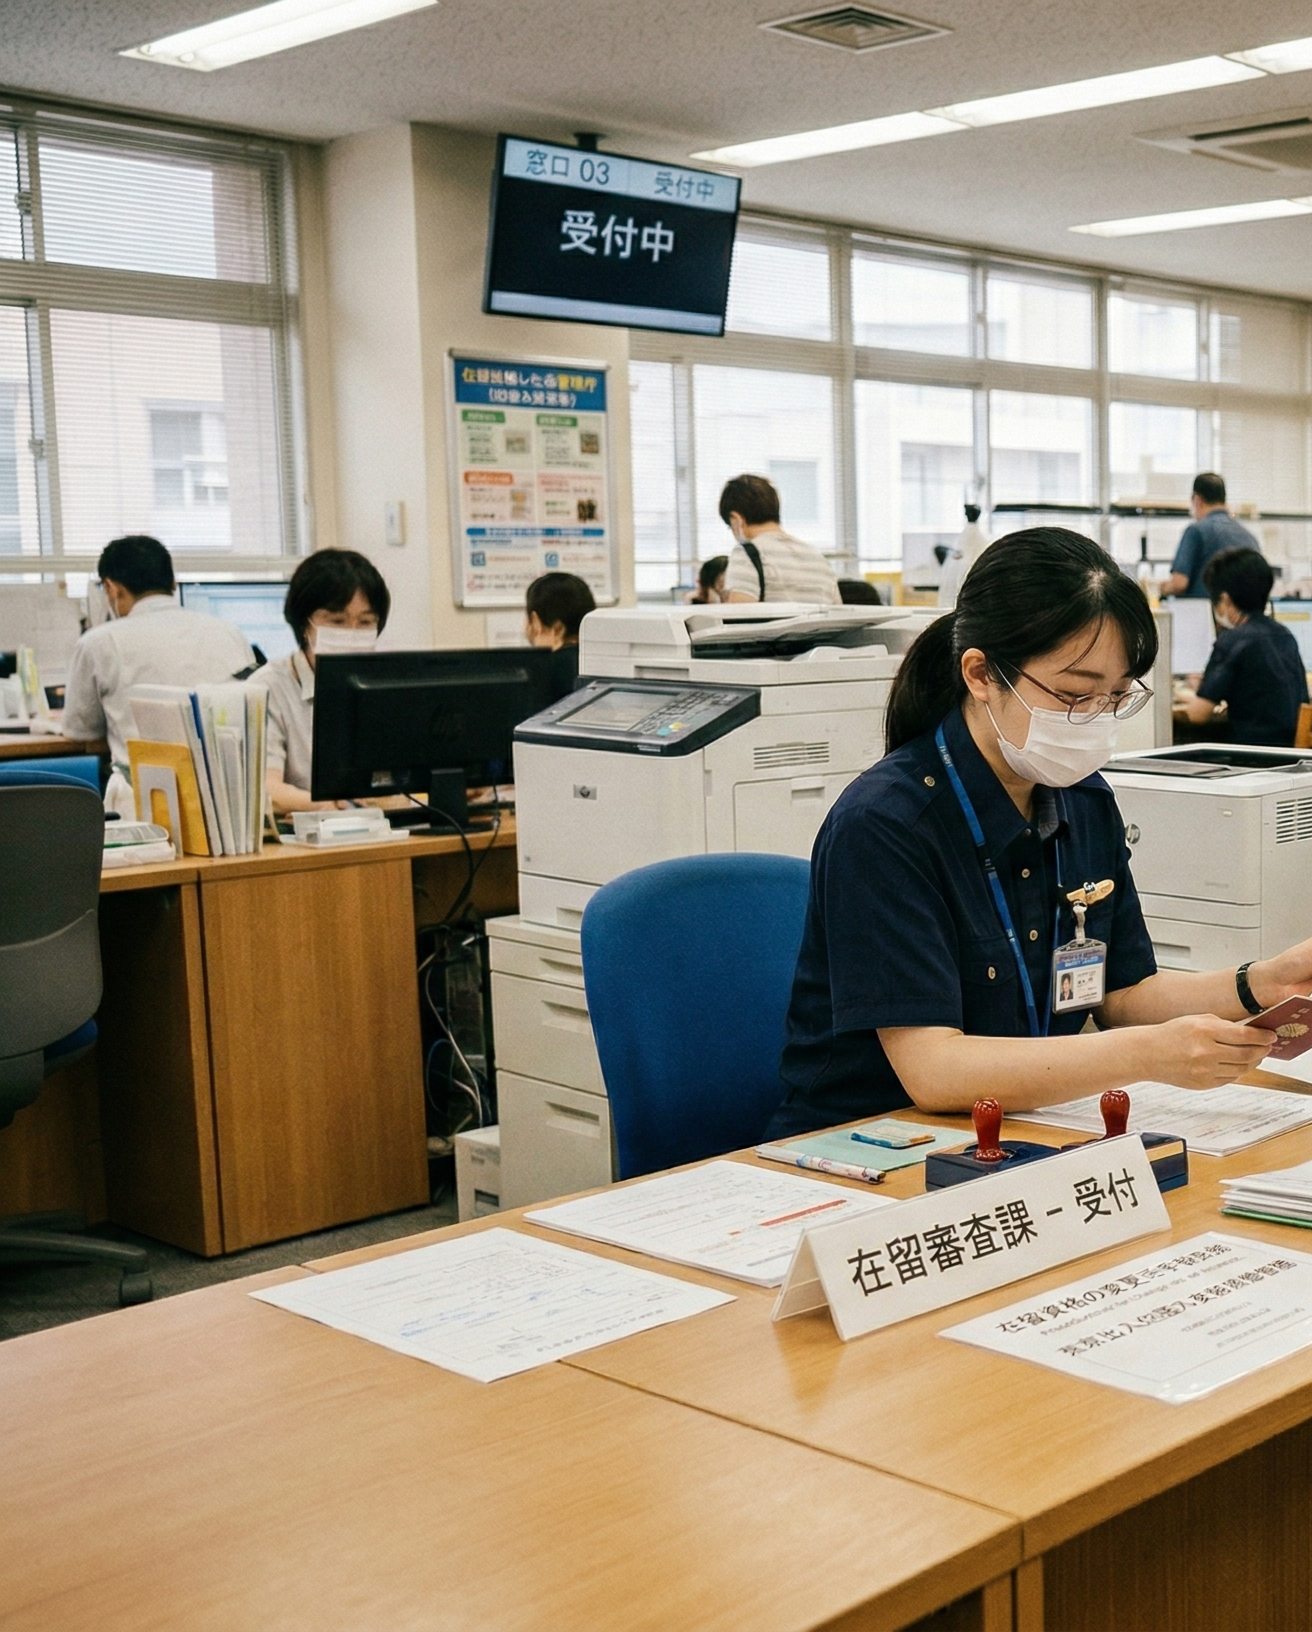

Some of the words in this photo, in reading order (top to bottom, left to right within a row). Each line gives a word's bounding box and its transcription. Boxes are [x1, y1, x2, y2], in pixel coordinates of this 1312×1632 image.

[526, 149, 570, 177] 窓口
[579, 159, 610, 185] 03
[654, 171, 715, 201] 受付中
[560, 209, 675, 262] 受付中
[847, 1199, 1039, 1296] 在留審査課
[1072, 1167, 1140, 1225] 受付
